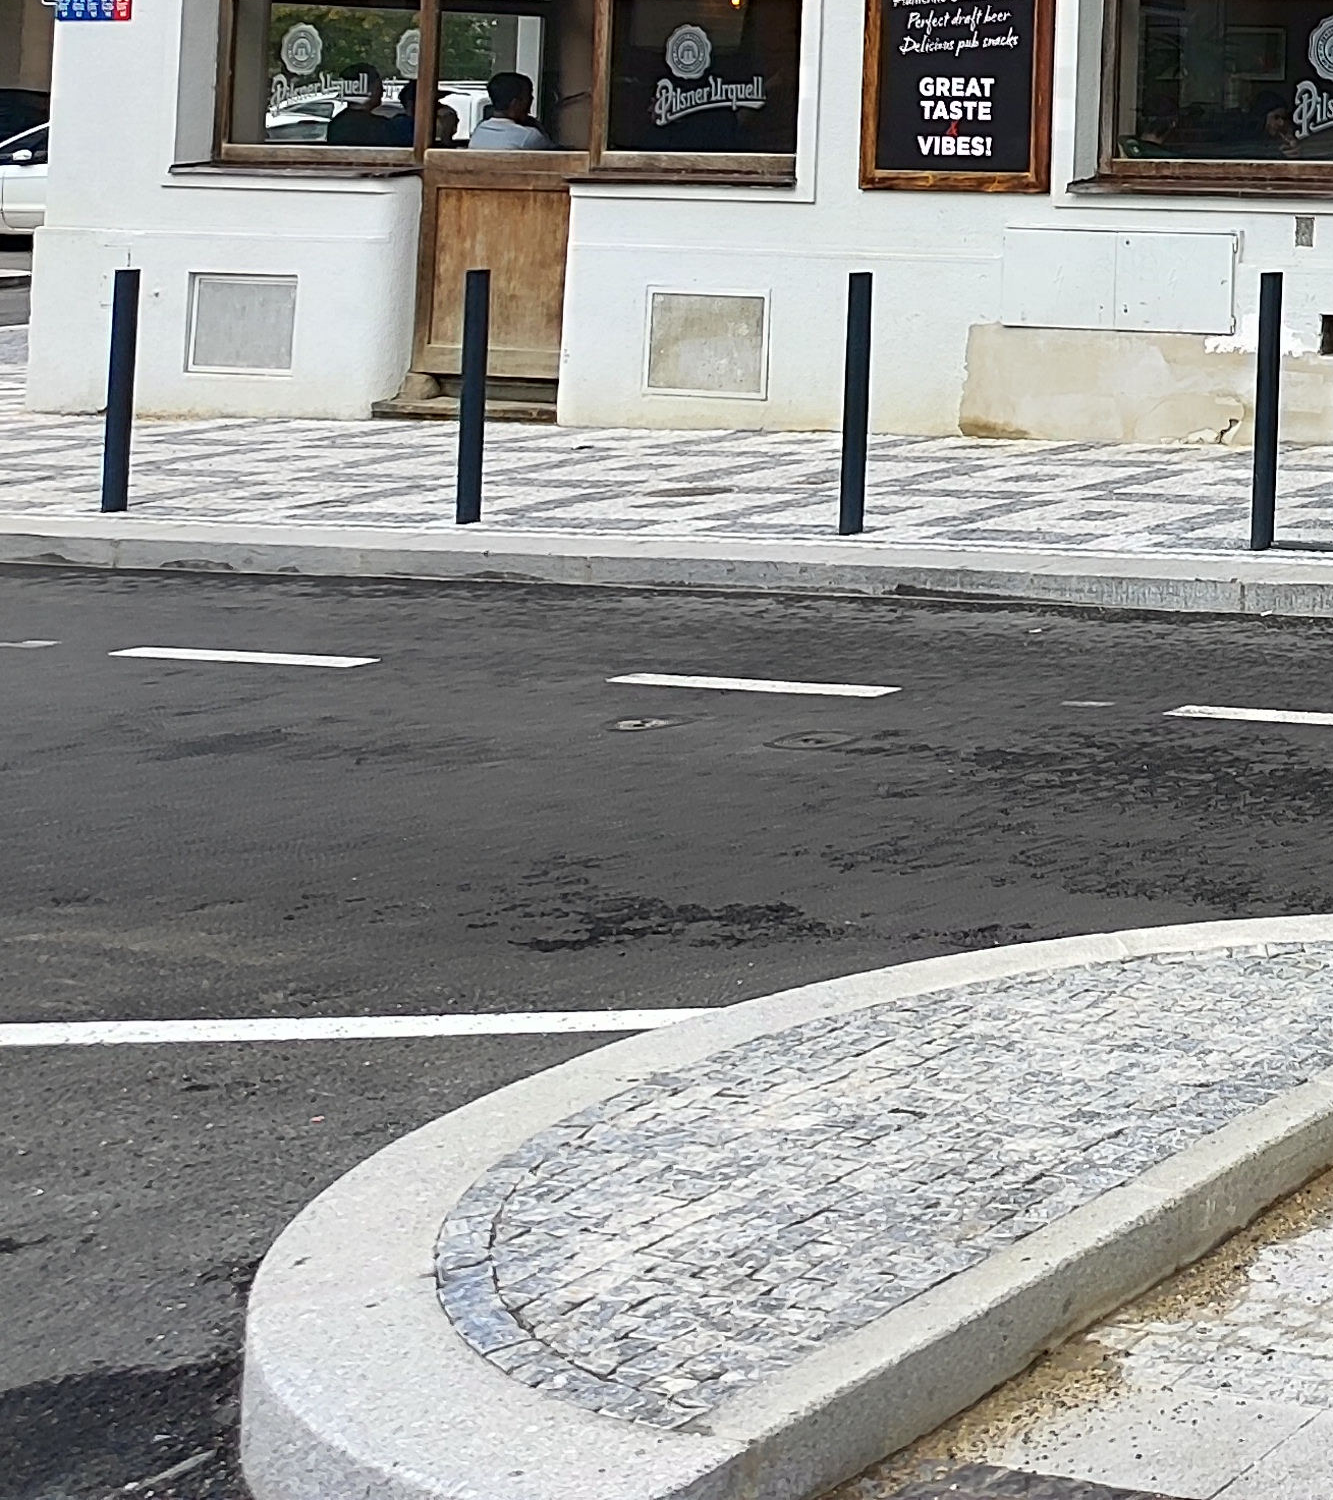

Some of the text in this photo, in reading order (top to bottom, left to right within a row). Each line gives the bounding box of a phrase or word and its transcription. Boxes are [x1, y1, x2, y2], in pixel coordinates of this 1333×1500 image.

[907, 5, 1012, 35] Perfect draft beer
[899, 26, 1019, 57] Delicious pub snacks
[269, 73, 321, 118] Pilsner
[319, 71, 368, 100] Urquell
[654, 75, 763, 126] Pilsner Urquell
[919, 77, 995, 97] GREAT
[920, 100, 992, 120] TASTE
[917, 135, 993, 156] VIBES!
